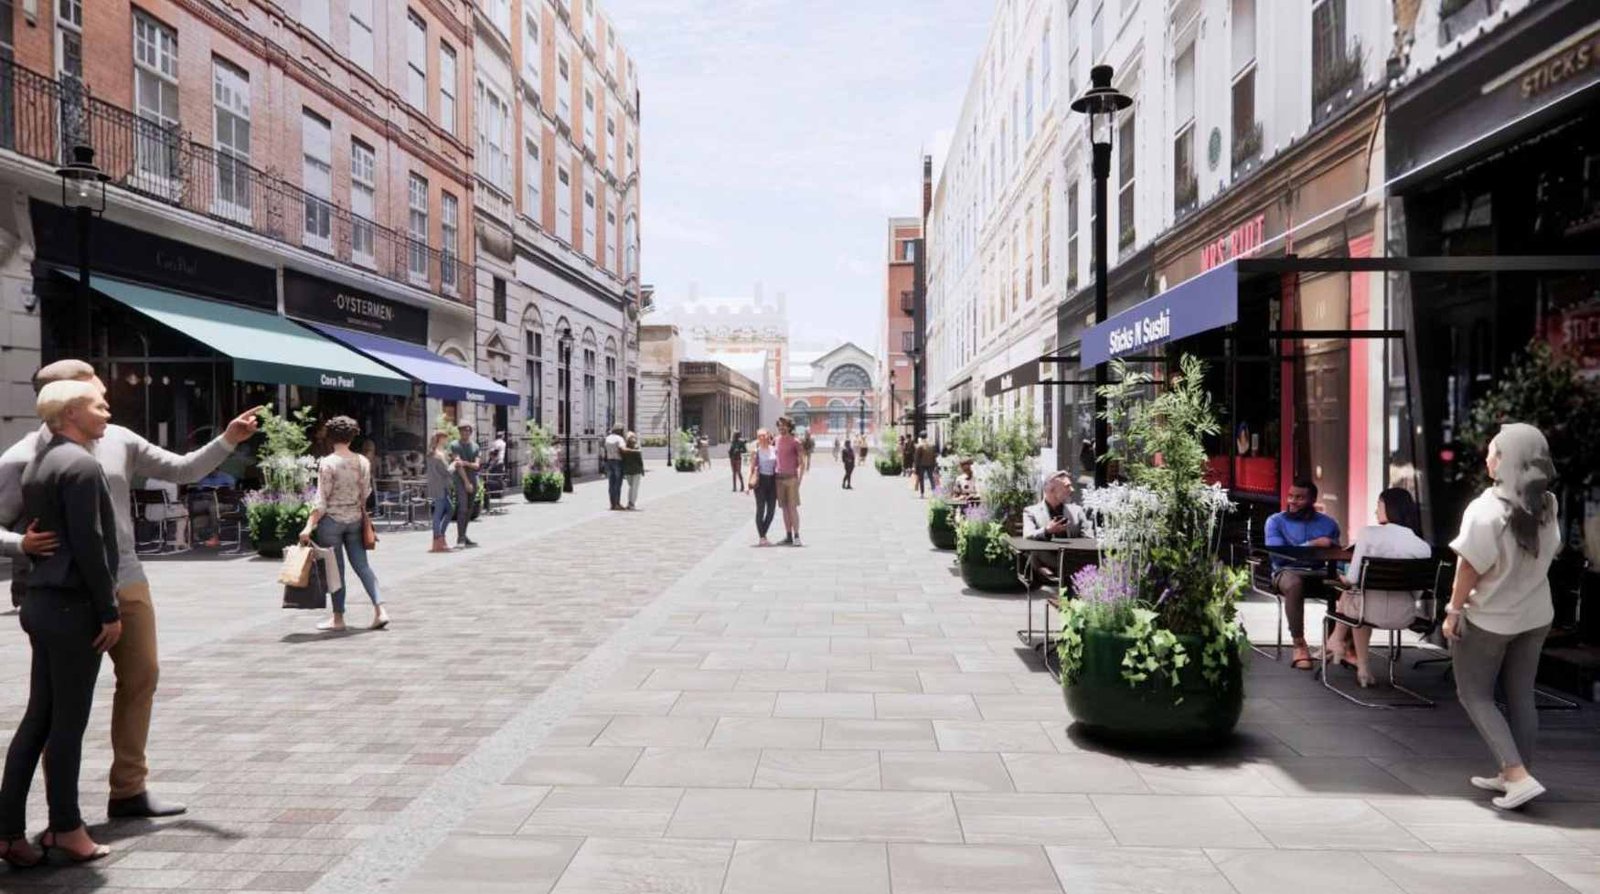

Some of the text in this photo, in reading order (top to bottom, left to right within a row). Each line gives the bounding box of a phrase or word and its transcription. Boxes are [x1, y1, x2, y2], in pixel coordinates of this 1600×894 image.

[1521, 45, 1589, 99] STICKS
[336, 293, 393, 320] OYSTERMEN
[1109, 308, 1170, 355] Sticks N Sushi
[320, 373, 355, 388] Cora Pearl
